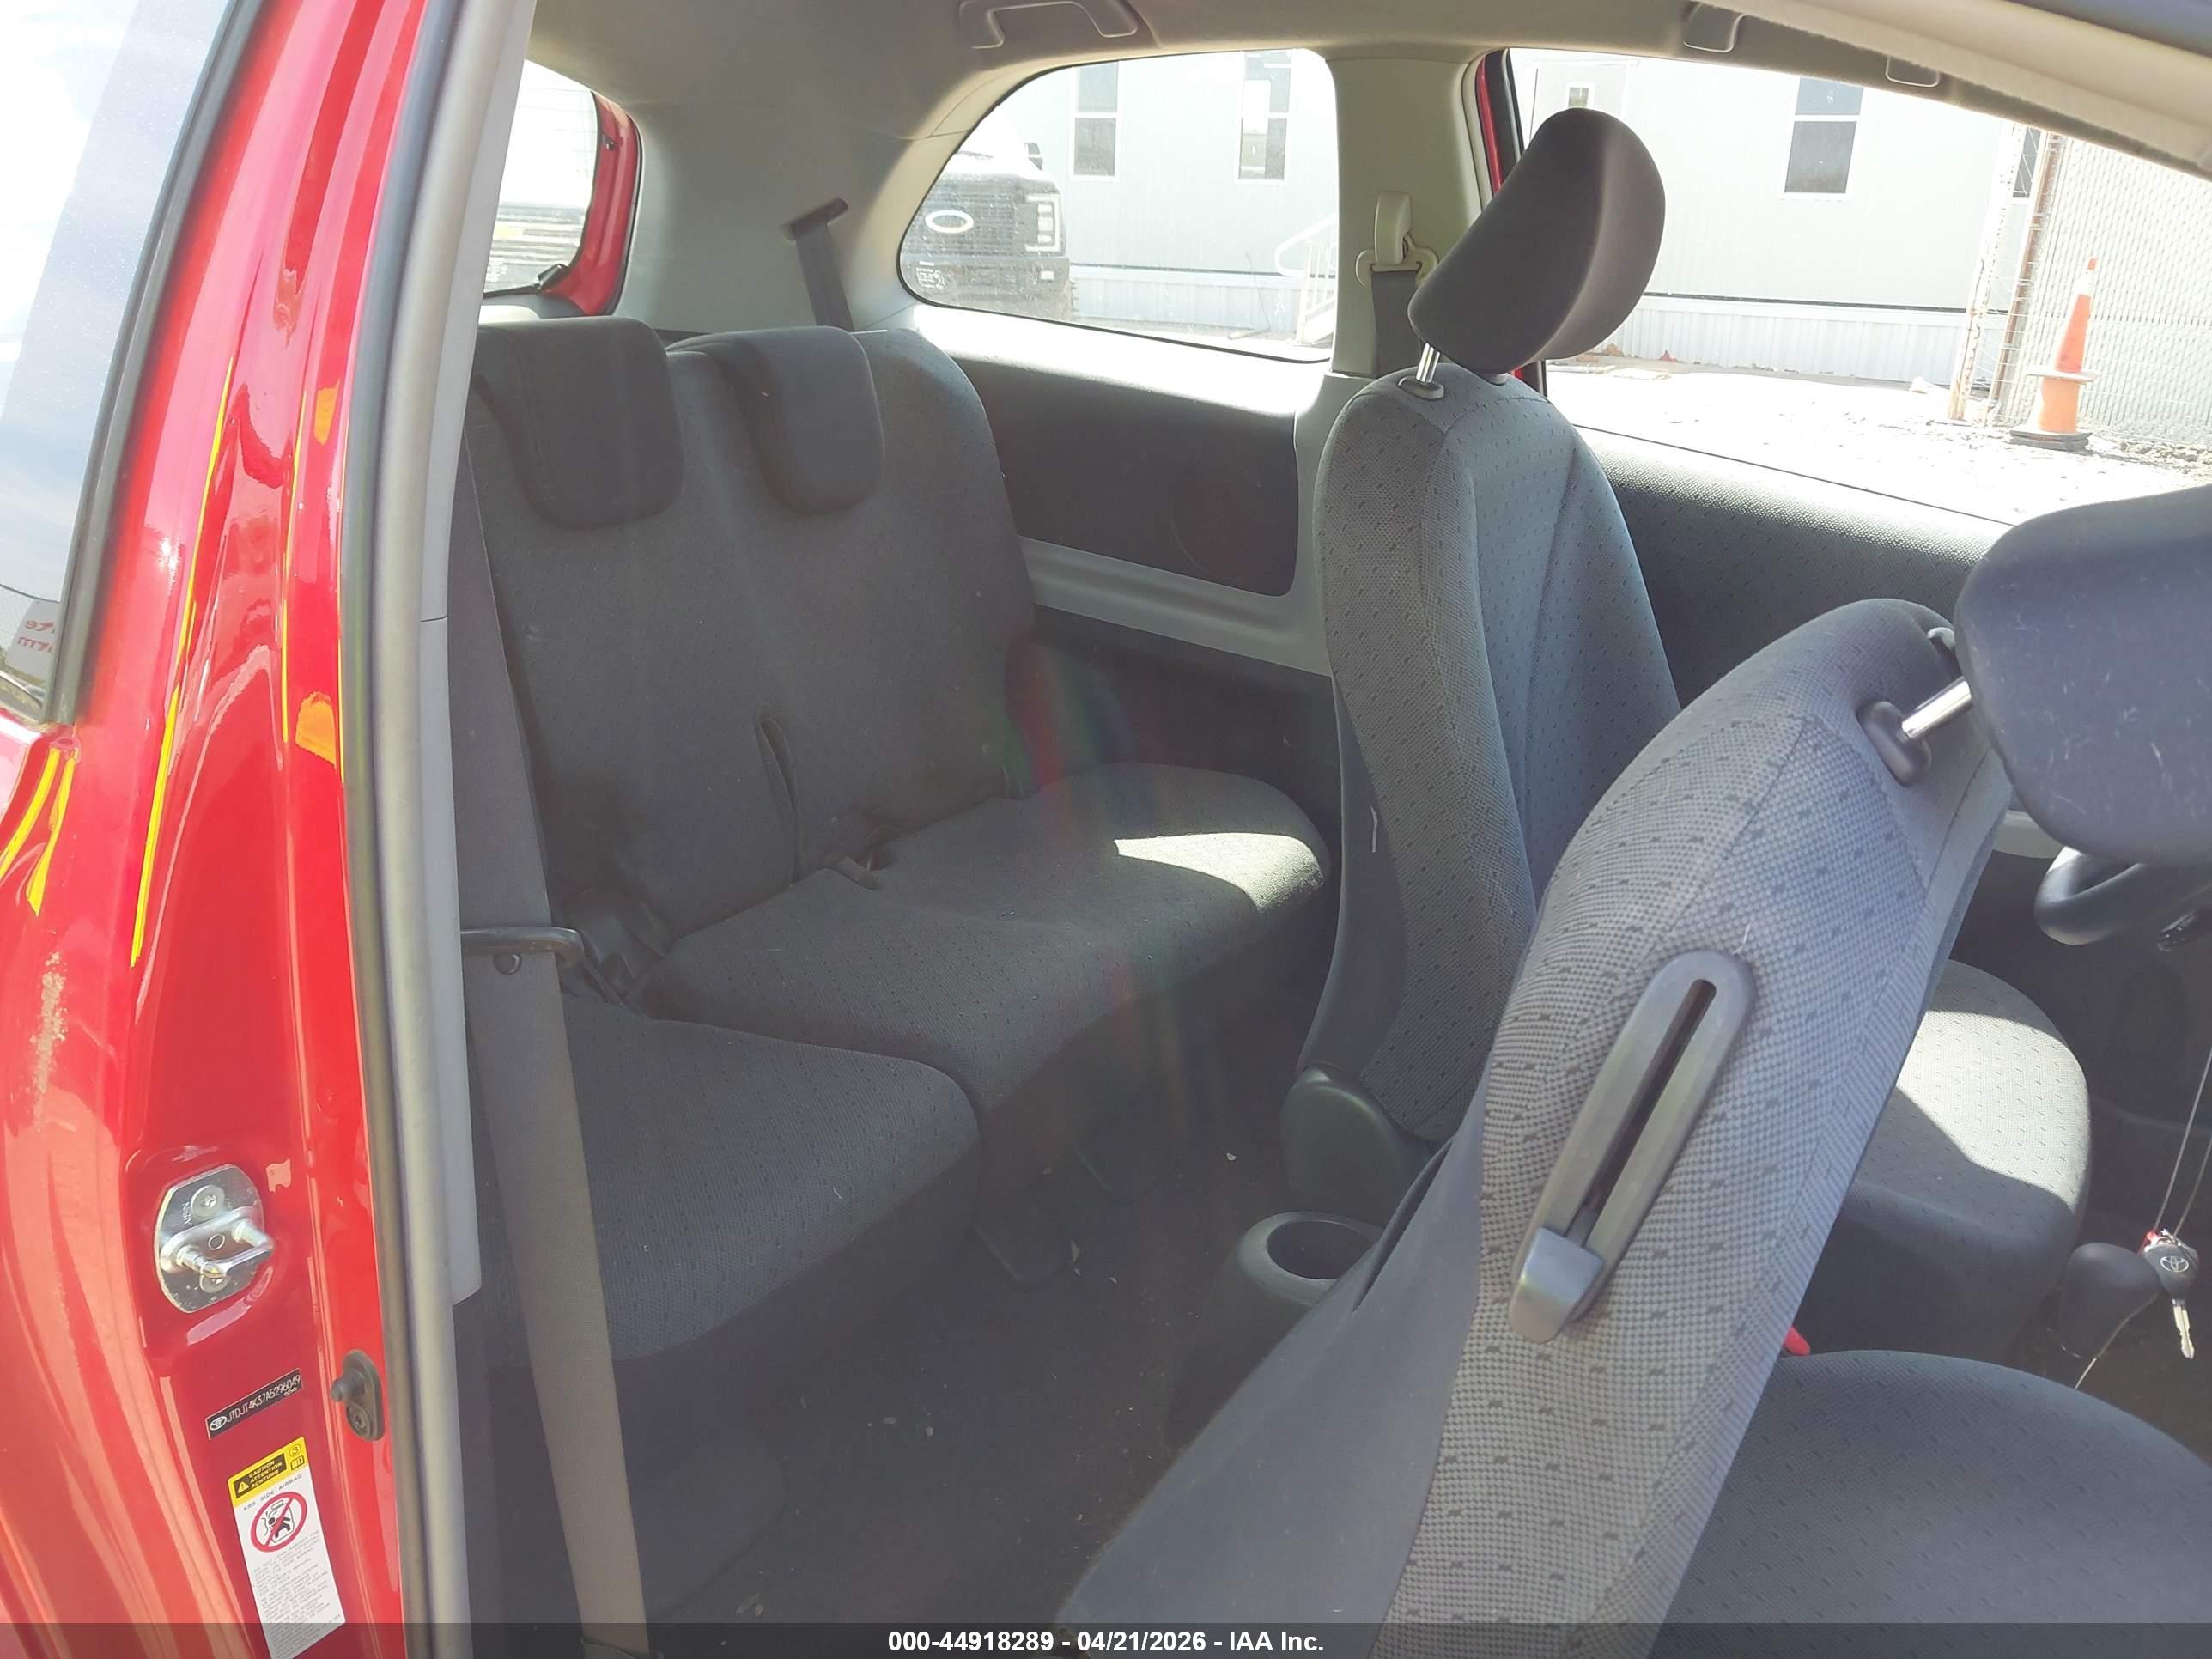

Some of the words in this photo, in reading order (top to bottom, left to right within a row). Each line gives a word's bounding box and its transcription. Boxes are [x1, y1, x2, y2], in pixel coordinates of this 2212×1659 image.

[227, 1375, 301, 1423] JTDJT4K37A5296049
[249, 1461, 275, 1478] CAUTION
[250, 1462, 283, 1484] ATTENTION
[251, 1469, 280, 1489] ACHTUNG
[243, 1501, 257, 1511] SRS
[259, 1490, 275, 1501] SIDE
[278, 1473, 302, 1491] AIRBAG
